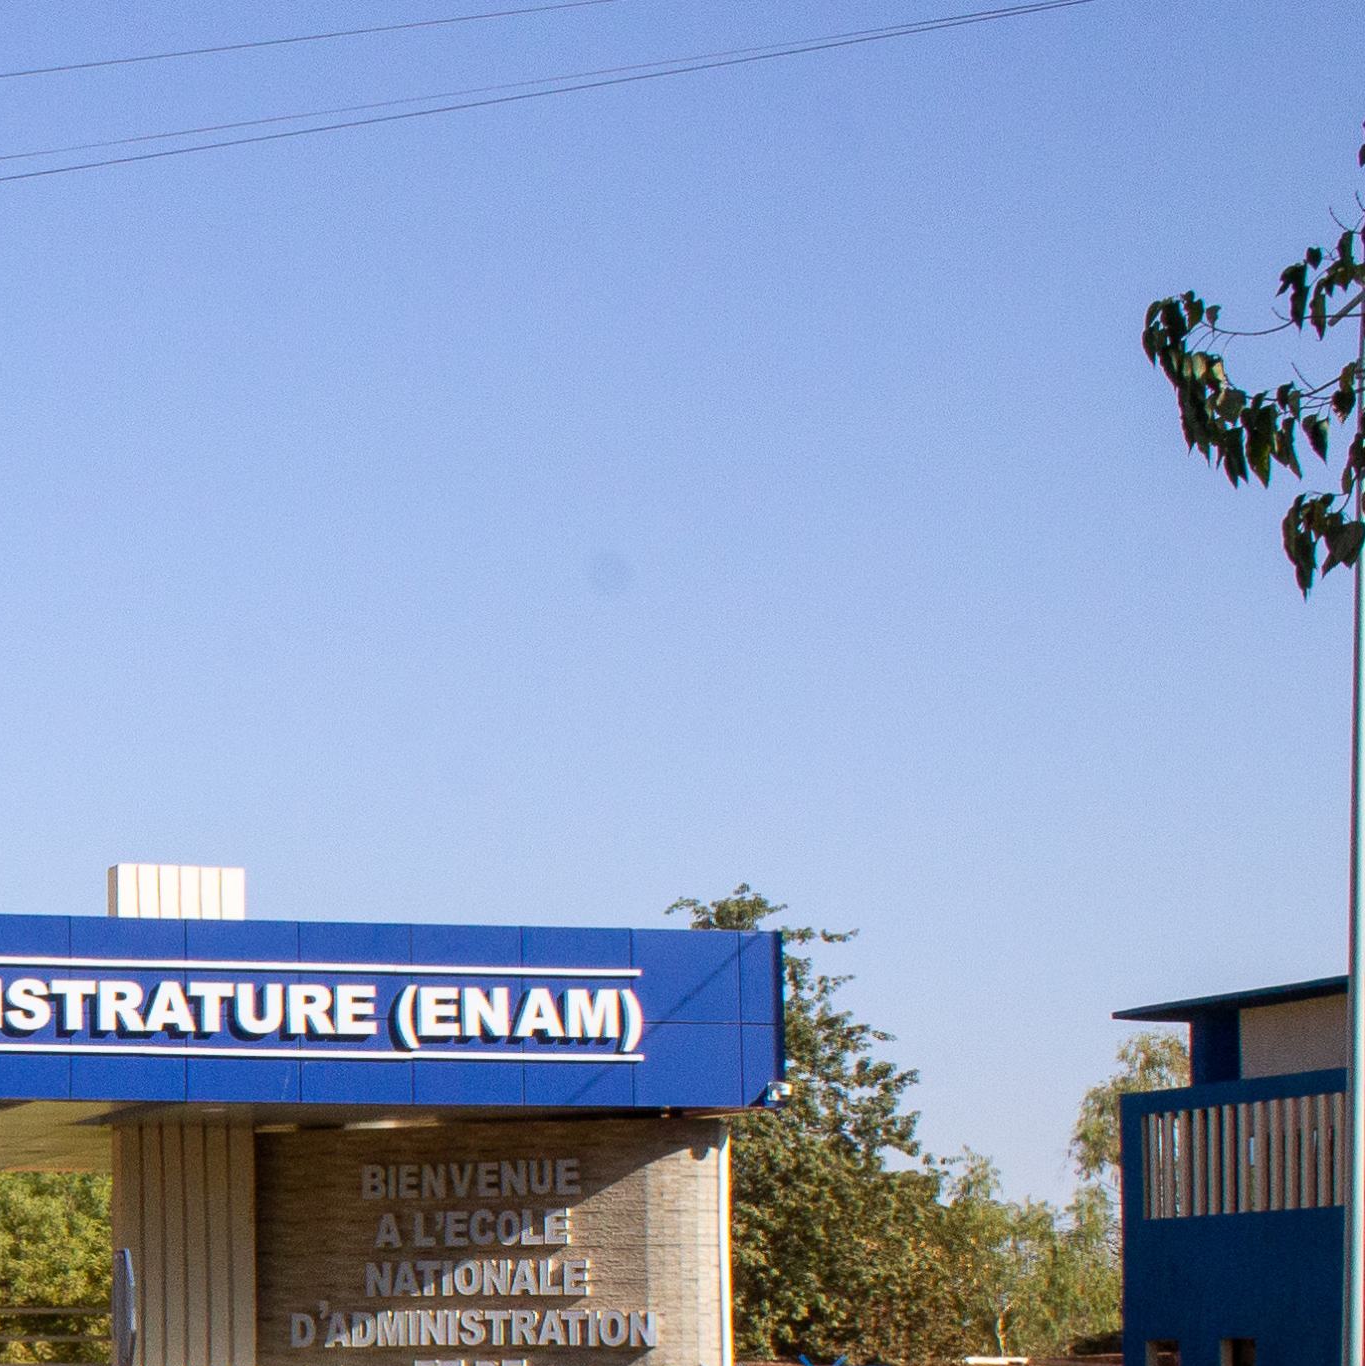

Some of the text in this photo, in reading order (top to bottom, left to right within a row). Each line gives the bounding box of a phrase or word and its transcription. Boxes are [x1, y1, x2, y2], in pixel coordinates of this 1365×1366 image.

[396, 984, 643, 1053] (ENAM)
[362, 1159, 581, 1200] BIENVENUE
[375, 1208, 571, 1248] A L'ECOLE
[365, 1259, 591, 1296] NATIONALE
[290, 1301, 657, 1348] D'ADMINISTRATION
